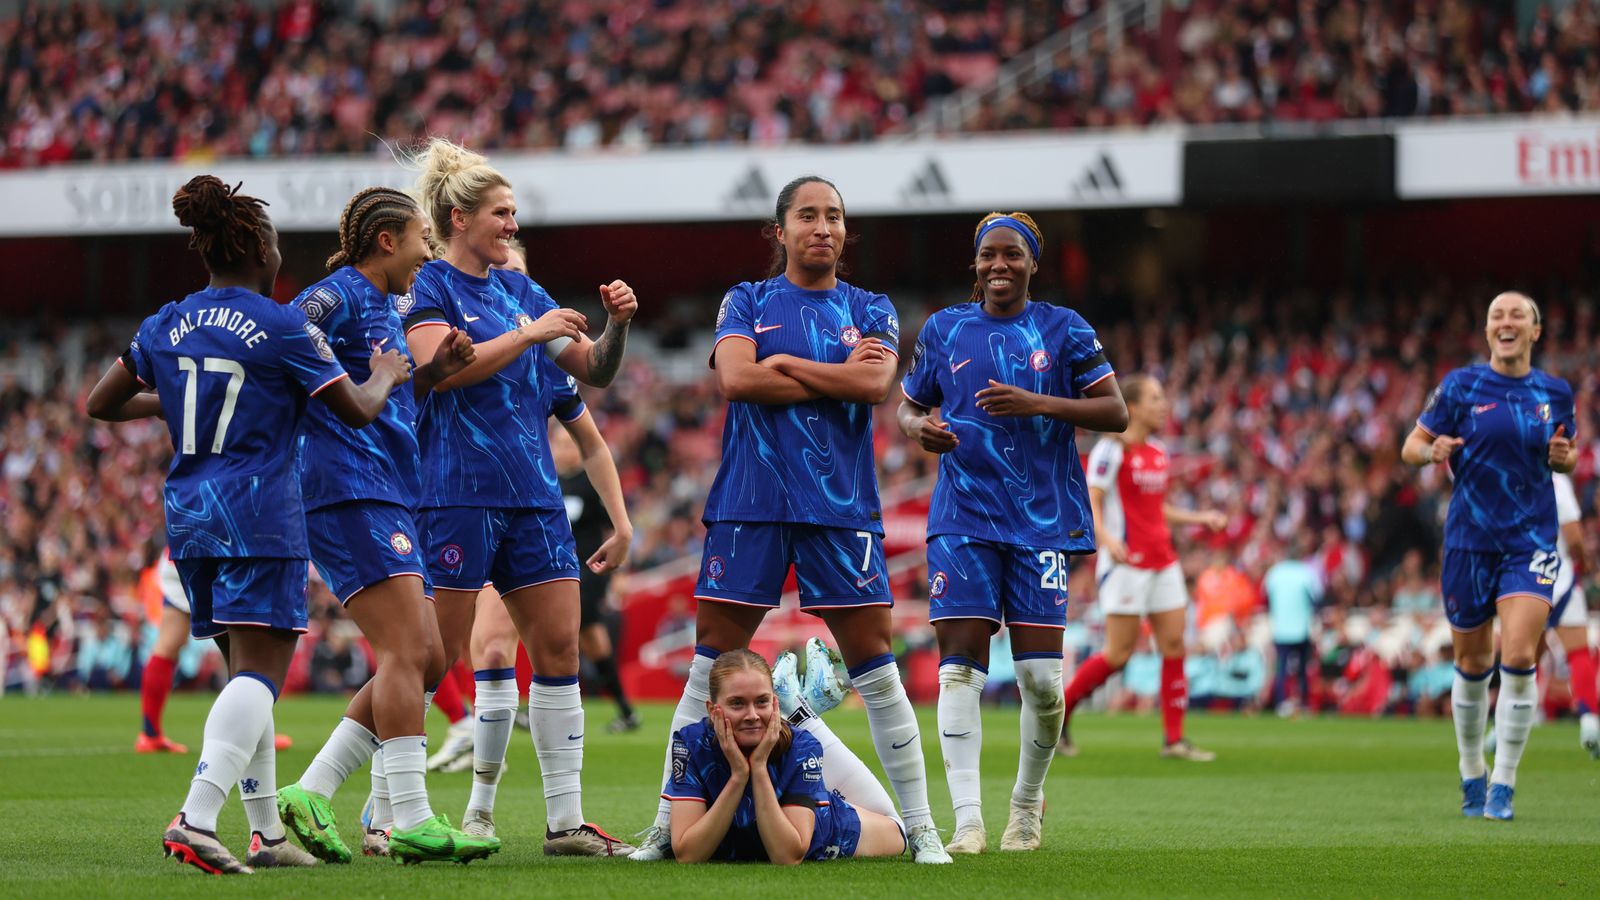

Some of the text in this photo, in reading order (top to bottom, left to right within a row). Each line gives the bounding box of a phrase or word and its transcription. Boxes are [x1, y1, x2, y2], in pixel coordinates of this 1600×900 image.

[169, 307, 268, 349] BALTIMORE
[178, 356, 245, 455] 17
[856, 531, 872, 571] 7
[1039, 551, 1067, 591] 26
[1529, 550, 1559, 581] 22
